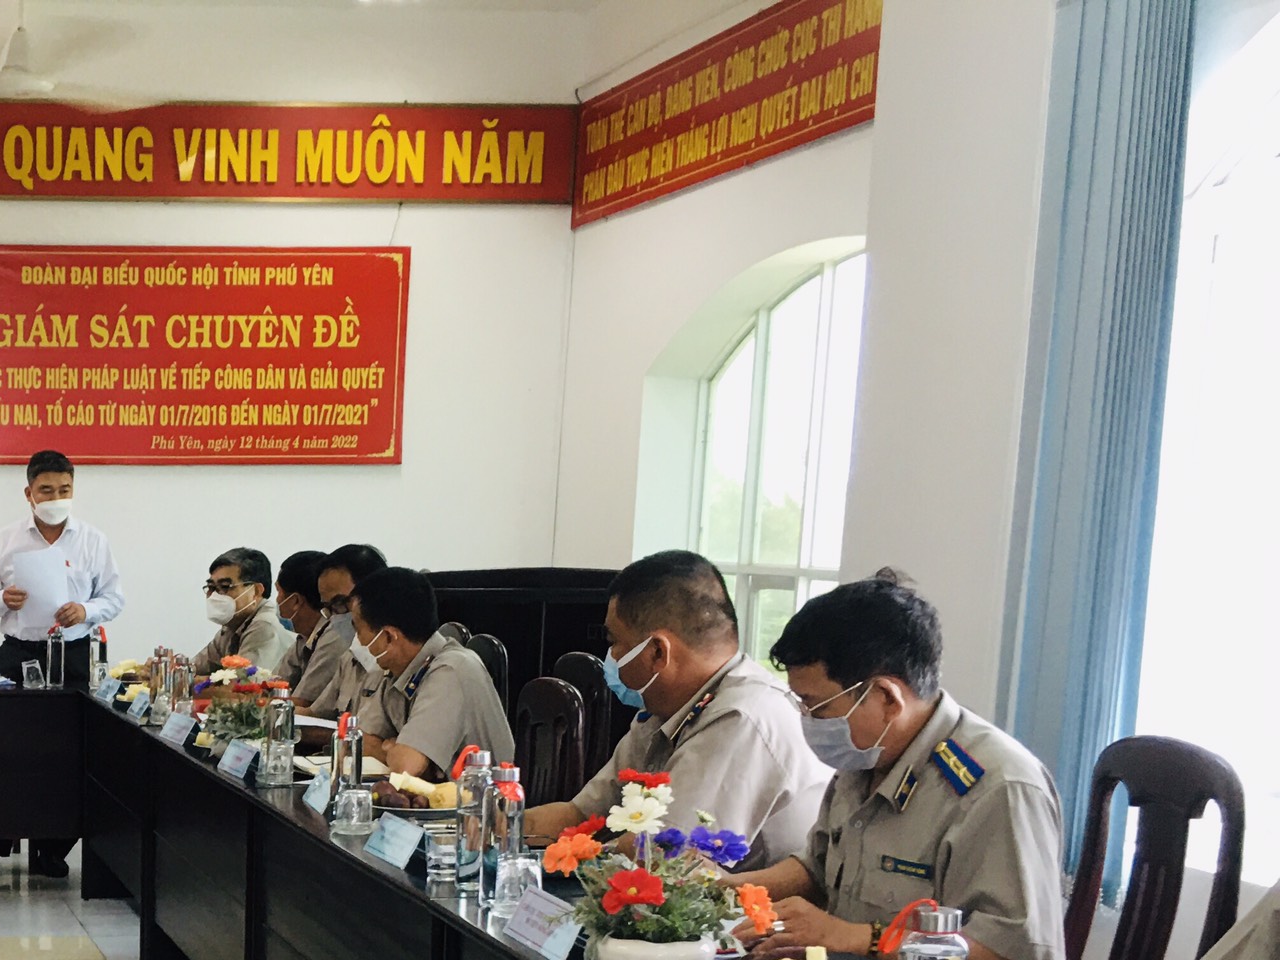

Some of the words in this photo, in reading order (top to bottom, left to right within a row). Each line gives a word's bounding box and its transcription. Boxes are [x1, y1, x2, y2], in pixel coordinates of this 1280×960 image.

[3, 125, 154, 190] QUANG
[173, 128, 280, 184] VINH
[295, 114, 426, 184] MUÔN
[442, 118, 544, 184] NĂM
[21, 262, 66, 285] ĐOÀN
[70, 266, 98, 289] ĐẠI
[102, 259, 139, 286] BIỂU
[144, 260, 187, 288] QUỐC
[192, 263, 218, 290] HỘI
[223, 261, 261, 286] TỈNH
[265, 263, 297, 286] PHÚ
[302, 263, 333, 286] YÊN
[89, 304, 155, 349] SÁT
[165, 305, 304, 349] CHUYÊN
[313, 296, 361, 348] ĐỀ
[6, 366, 42, 394] THỰC
[45, 363, 79, 394] HIỆN
[82, 363, 120, 390] PHÁP
[123, 363, 157, 394] LUẬT
[160, 361, 177, 390] VỀ
[180, 361, 211, 390] TIẾP
[214, 363, 253, 390] CÔNG
[256, 363, 286, 390] DÂN
[288, 364, 307, 390] VÀ
[310, 361, 339, 390] GIẢI
[342, 361, 385, 392] QUYẾT
[13, 404, 42, 431] NẠI,
[46, 397, 63, 426] TỐ
[66, 400, 95, 426] CÁO
[98, 400, 117, 427] TỪ
[119, 400, 157, 427] NGÀY
[160, 404, 227, 427] 01/7/2016
[230, 398, 259, 426] ĐẾN
[262, 400, 300, 426] NGÀY
[151, 435, 175, 450] Phú
[179, 435, 204, 451] Yên,
[207, 436, 236, 452] ngày
[239, 435, 253, 449] 12
[255, 436, 290, 452] tháng
[292, 435, 300, 449] 4
[302, 436, 329, 449] năm
[331, 435, 359, 449] 2022
